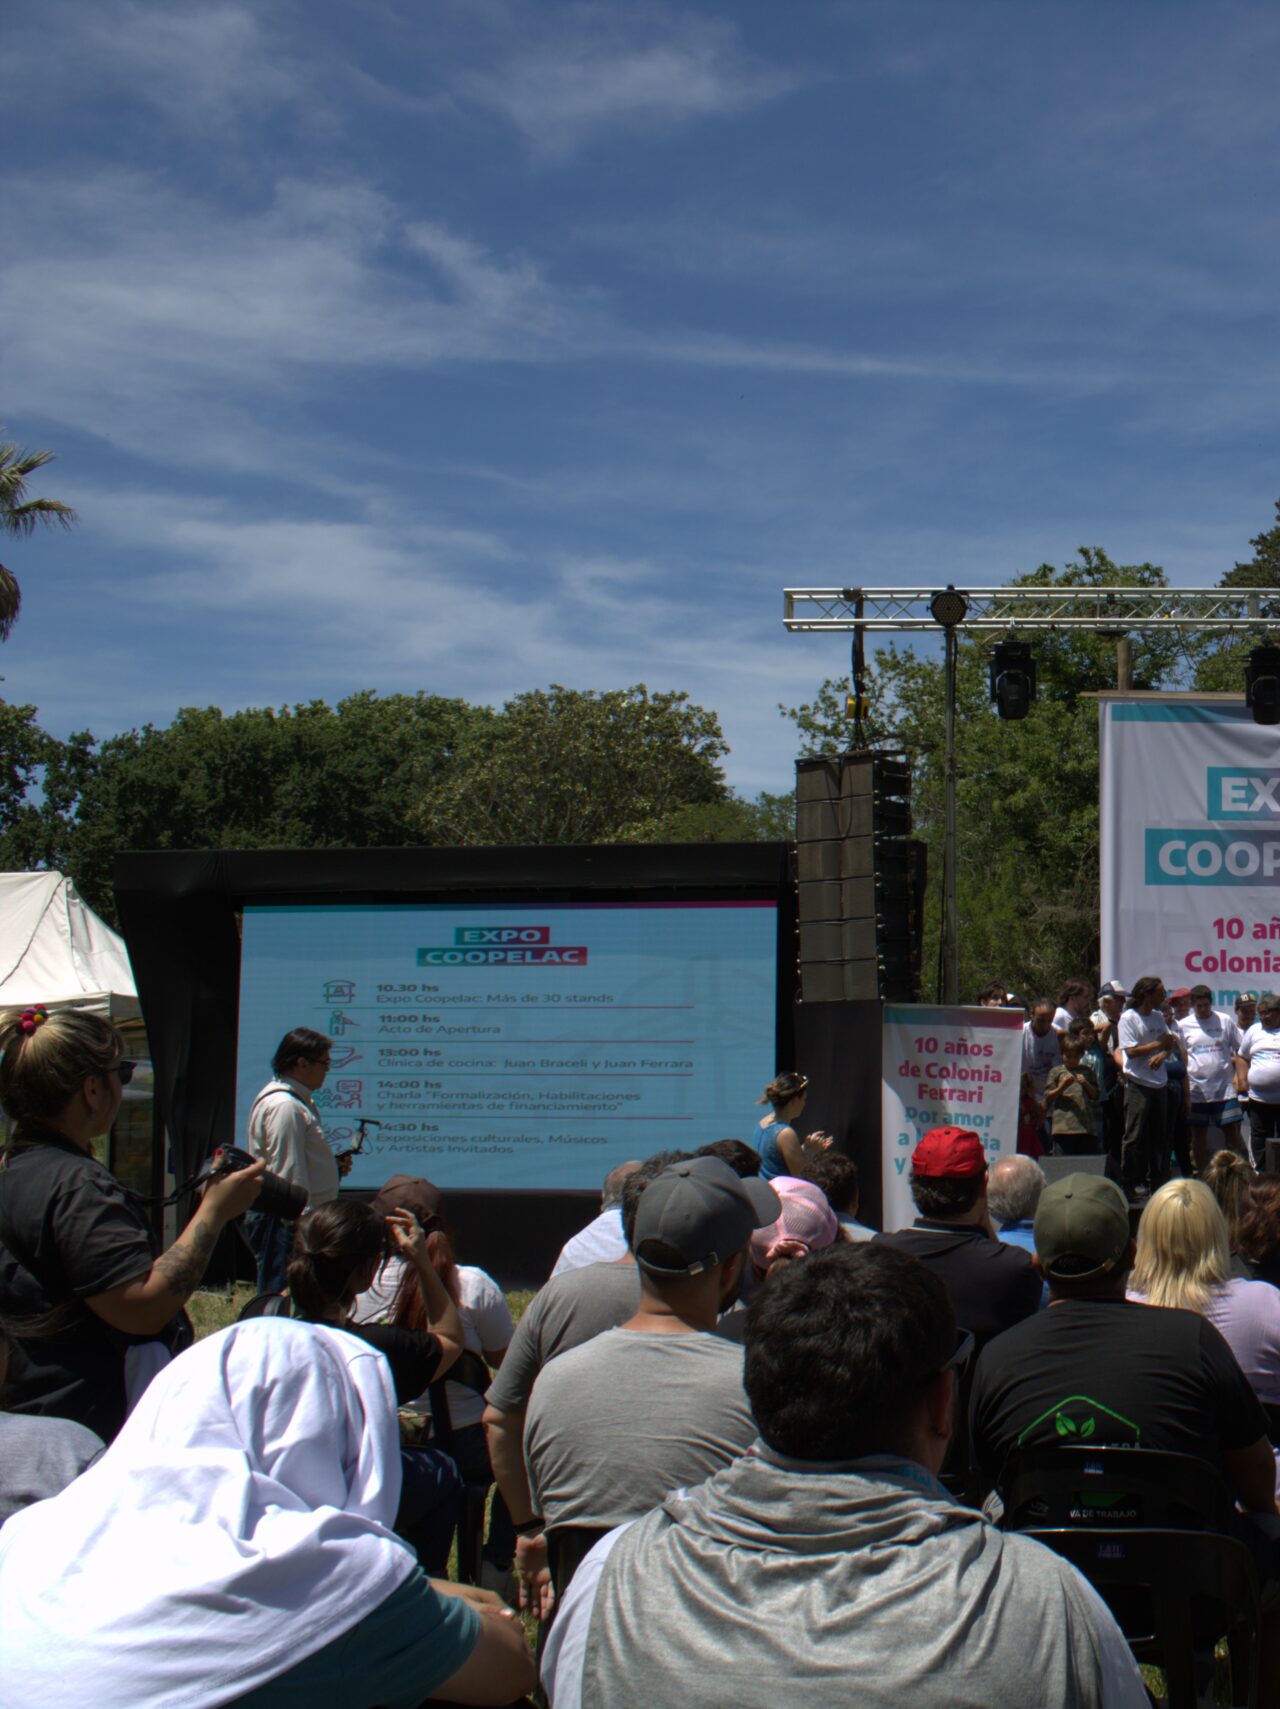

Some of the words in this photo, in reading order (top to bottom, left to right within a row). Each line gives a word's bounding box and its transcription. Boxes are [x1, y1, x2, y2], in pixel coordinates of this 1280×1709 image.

[1212, 918, 1244, 940] 10
[463, 930, 541, 942] EXPO
[425, 950, 580, 964] COOPELAC
[421, 983, 440, 993] hs
[376, 994, 412, 1004] Expo
[416, 994, 483, 1004] Coopelac:
[486, 992, 517, 1003] Más
[520, 993, 539, 1003] de
[543, 994, 561, 1003] 30
[564, 993, 614, 1003] stands
[378, 1014, 417, 1023] 11:00
[421, 1014, 441, 1023] hs
[378, 1025, 411, 1034] Acto
[415, 1025, 433, 1034] de
[436, 1025, 501, 1036] Apertura
[377, 1048, 419, 1057] 13:00
[422, 1048, 442, 1057] hs
[915, 1037, 939, 1054] 10
[944, 1036, 994, 1057] años
[377, 1058, 423, 1069] Clínica
[425, 1059, 445, 1068] de
[447, 1059, 497, 1068] cocina:
[504, 1059, 537, 1069] Juan
[592, 1061, 601, 1070] y
[604, 1060, 637, 1070] Juan
[640, 1060, 694, 1069] Ferrara
[898, 1060, 921, 1078] de
[925, 1062, 1002, 1083] Colonia
[377, 1080, 419, 1089] 14:00
[424, 1080, 442, 1089] hs
[377, 1090, 423, 1100] Charla
[538, 1091, 641, 1101] Habilitaciones
[917, 1083, 984, 1104] Ferrari
[376, 1103, 386, 1112] y
[389, 1101, 484, 1111] herramientas
[487, 1101, 505, 1111] de
[905, 1106, 938, 1124] Por
[943, 1111, 994, 1128] amor
[421, 1122, 439, 1131] hs
[376, 1133, 467, 1143] Exposiciones
[470, 1134, 545, 1145] culturales,
[548, 1133, 608, 1145] Músicos
[897, 1132, 910, 1146] a
[376, 1146, 385, 1154] y
[388, 1144, 445, 1153] Artistas
[447, 1144, 515, 1153] Invitados
[894, 1157, 907, 1175] y
[1082, 1508, 1094, 1518] DE
[1096, 1509, 1137, 1519] TRABAJO
